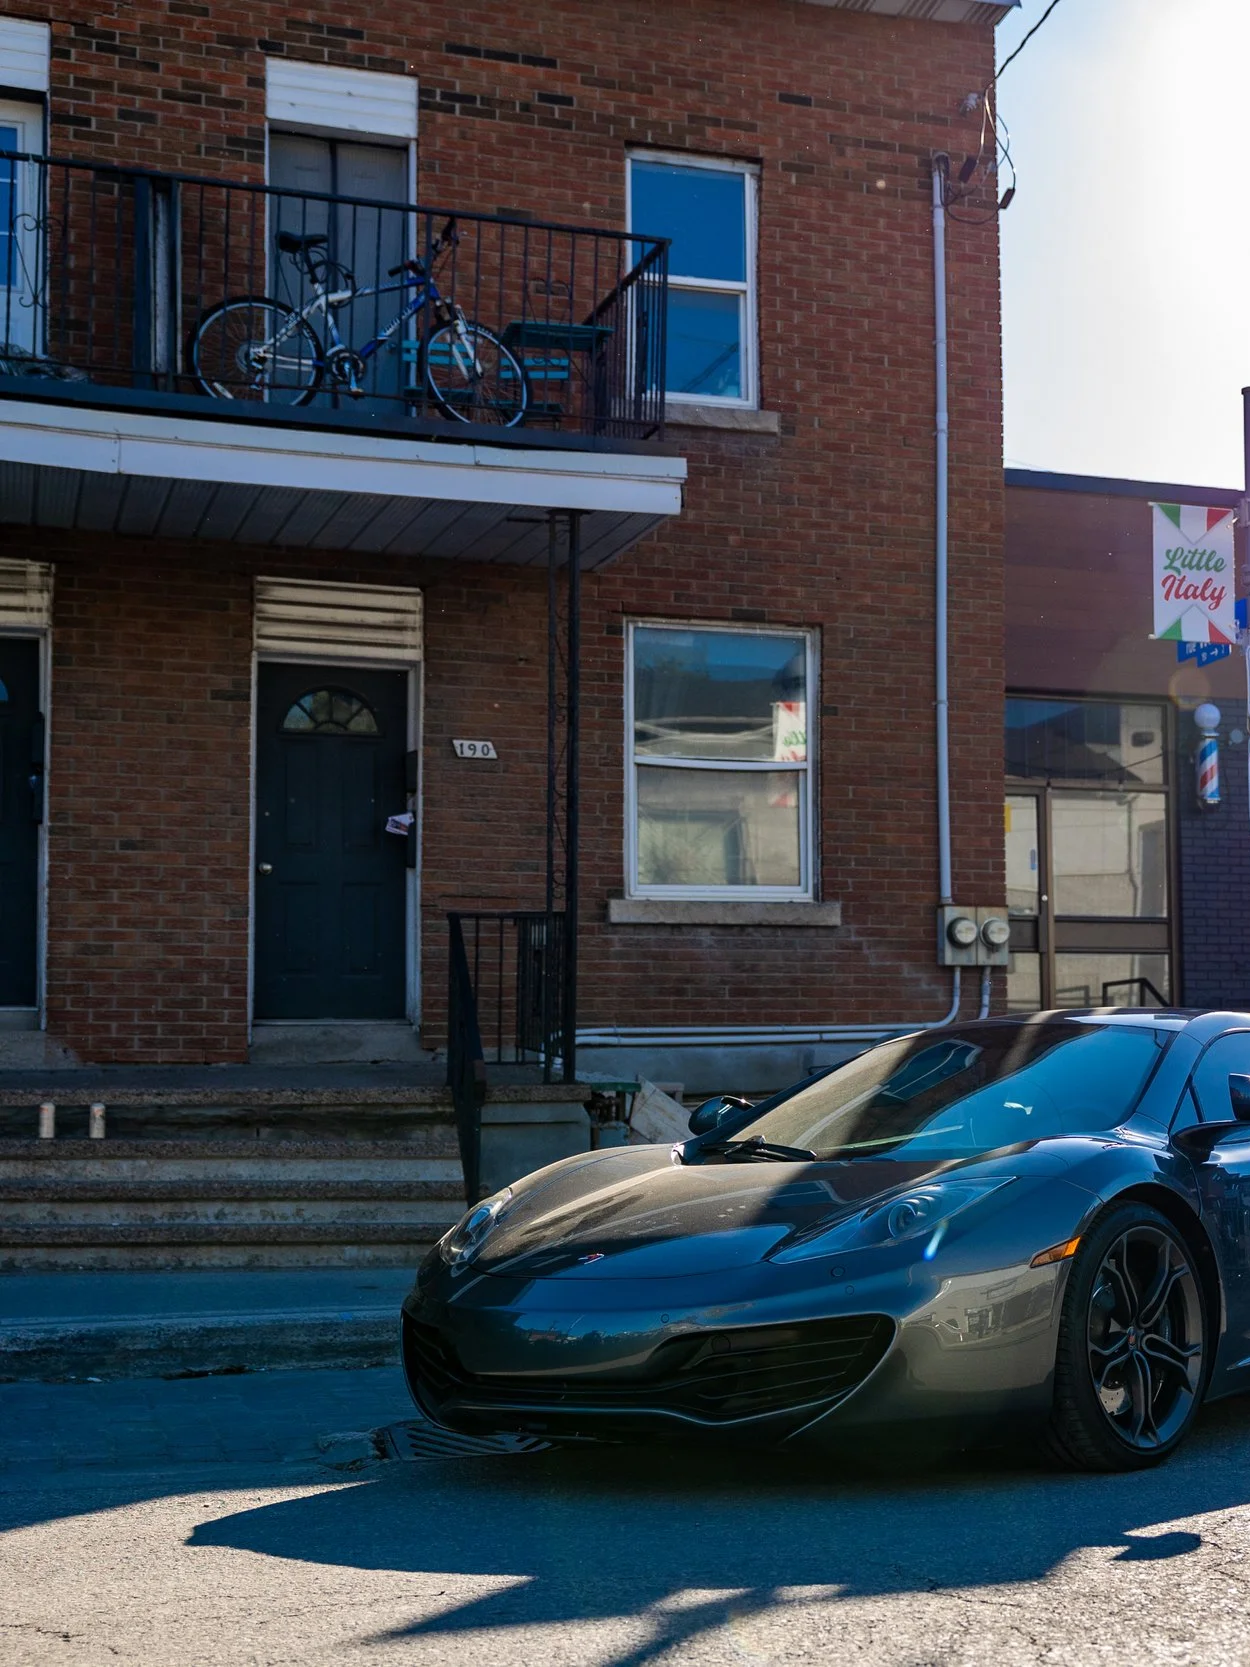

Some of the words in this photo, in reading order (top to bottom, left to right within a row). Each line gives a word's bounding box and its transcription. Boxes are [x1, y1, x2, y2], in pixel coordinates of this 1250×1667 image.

[1163, 546, 1227, 576] Little
[1161, 574, 1227, 611] Italy
[459, 742, 490, 757] 190
